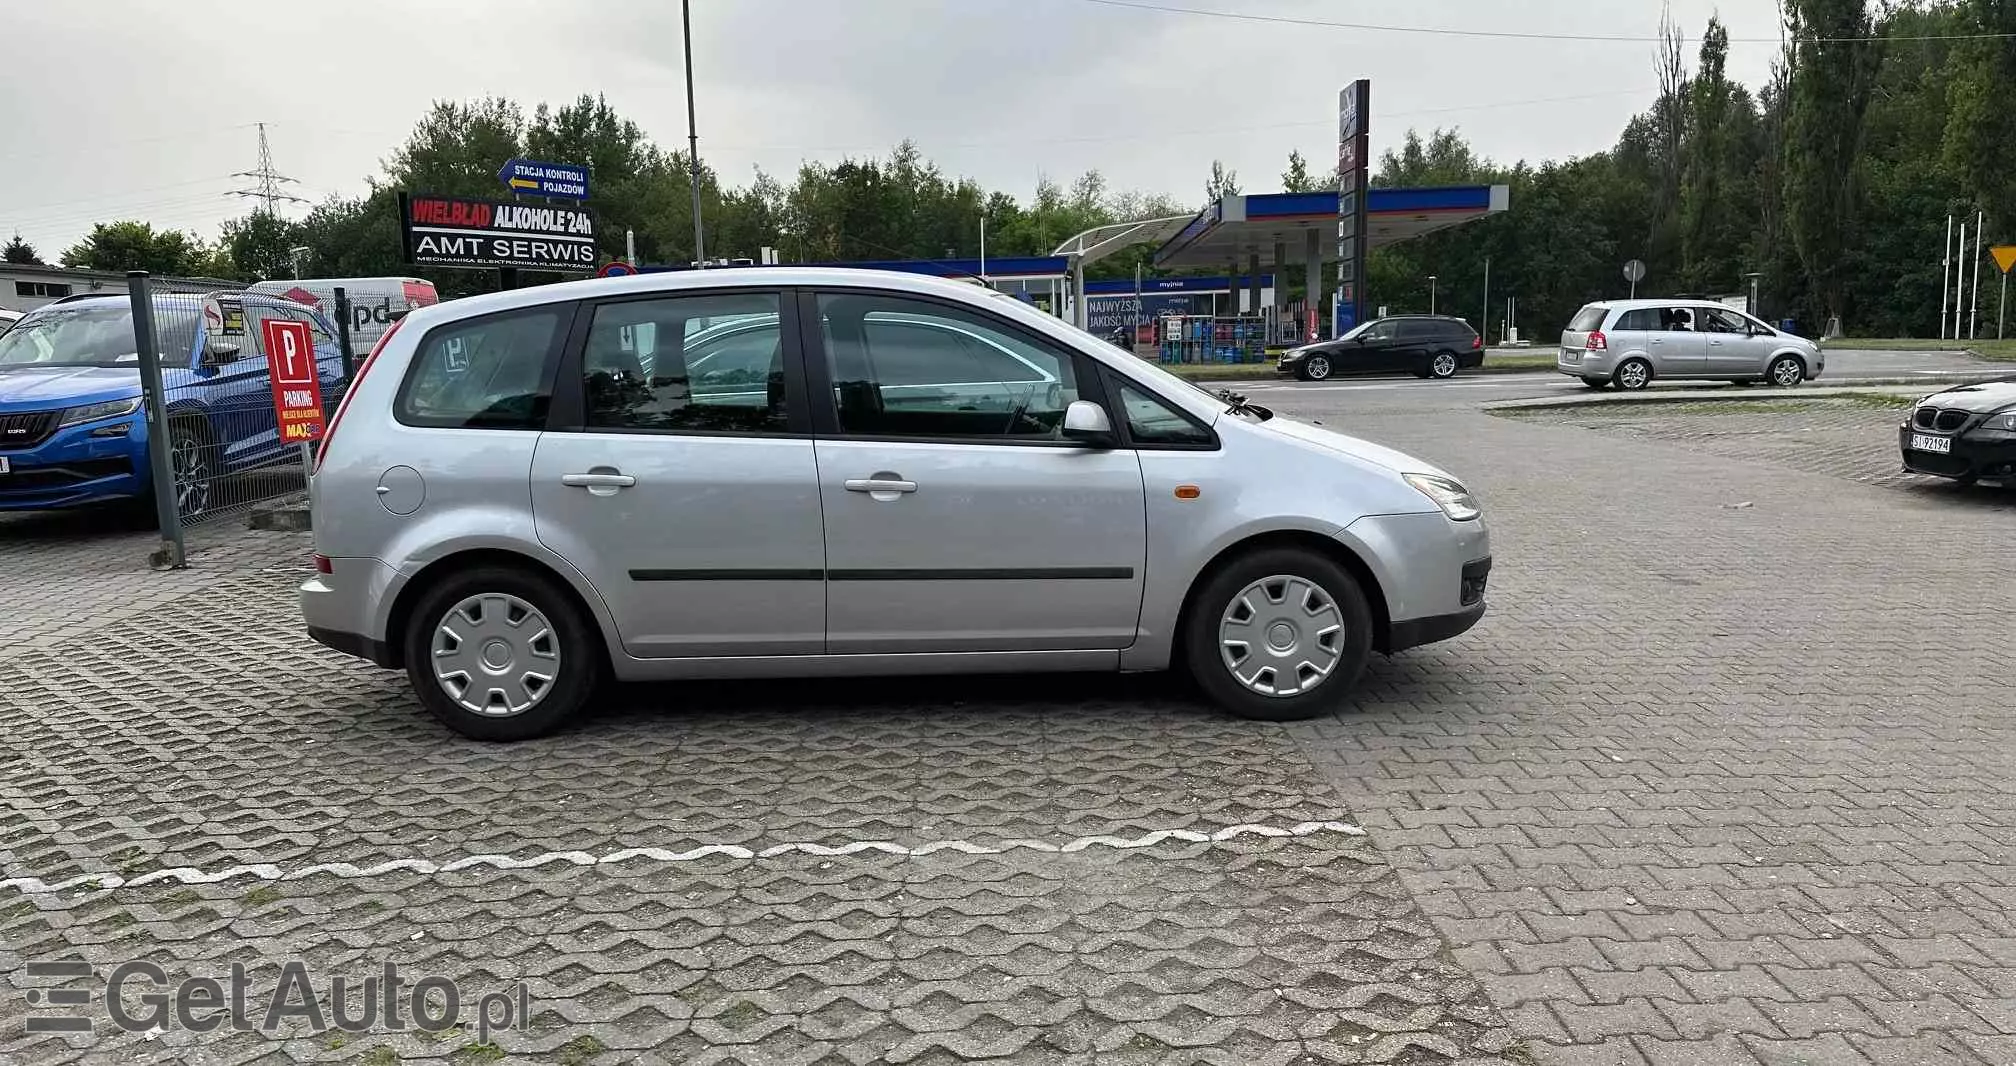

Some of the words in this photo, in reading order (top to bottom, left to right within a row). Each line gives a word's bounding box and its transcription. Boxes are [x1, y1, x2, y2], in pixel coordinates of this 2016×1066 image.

[514, 165, 544, 178] STACJA
[545, 169, 584, 182] KONTROLI
[543, 182, 584, 195] POJAZDÓW
[493, 205, 565, 232] ALKOHOLE
[566, 211, 592, 234] 24h
[416, 236, 484, 255] AMT
[493, 239, 594, 262] SERWIS
[477, 258, 538, 266] ELEKTRONIKA
[539, 261, 594, 269] KLIMATYZACJA
[1089, 312, 1121, 327] JAKOŚĆ
[282, 329, 297, 376] P
[283, 390, 313, 408] PARKING
